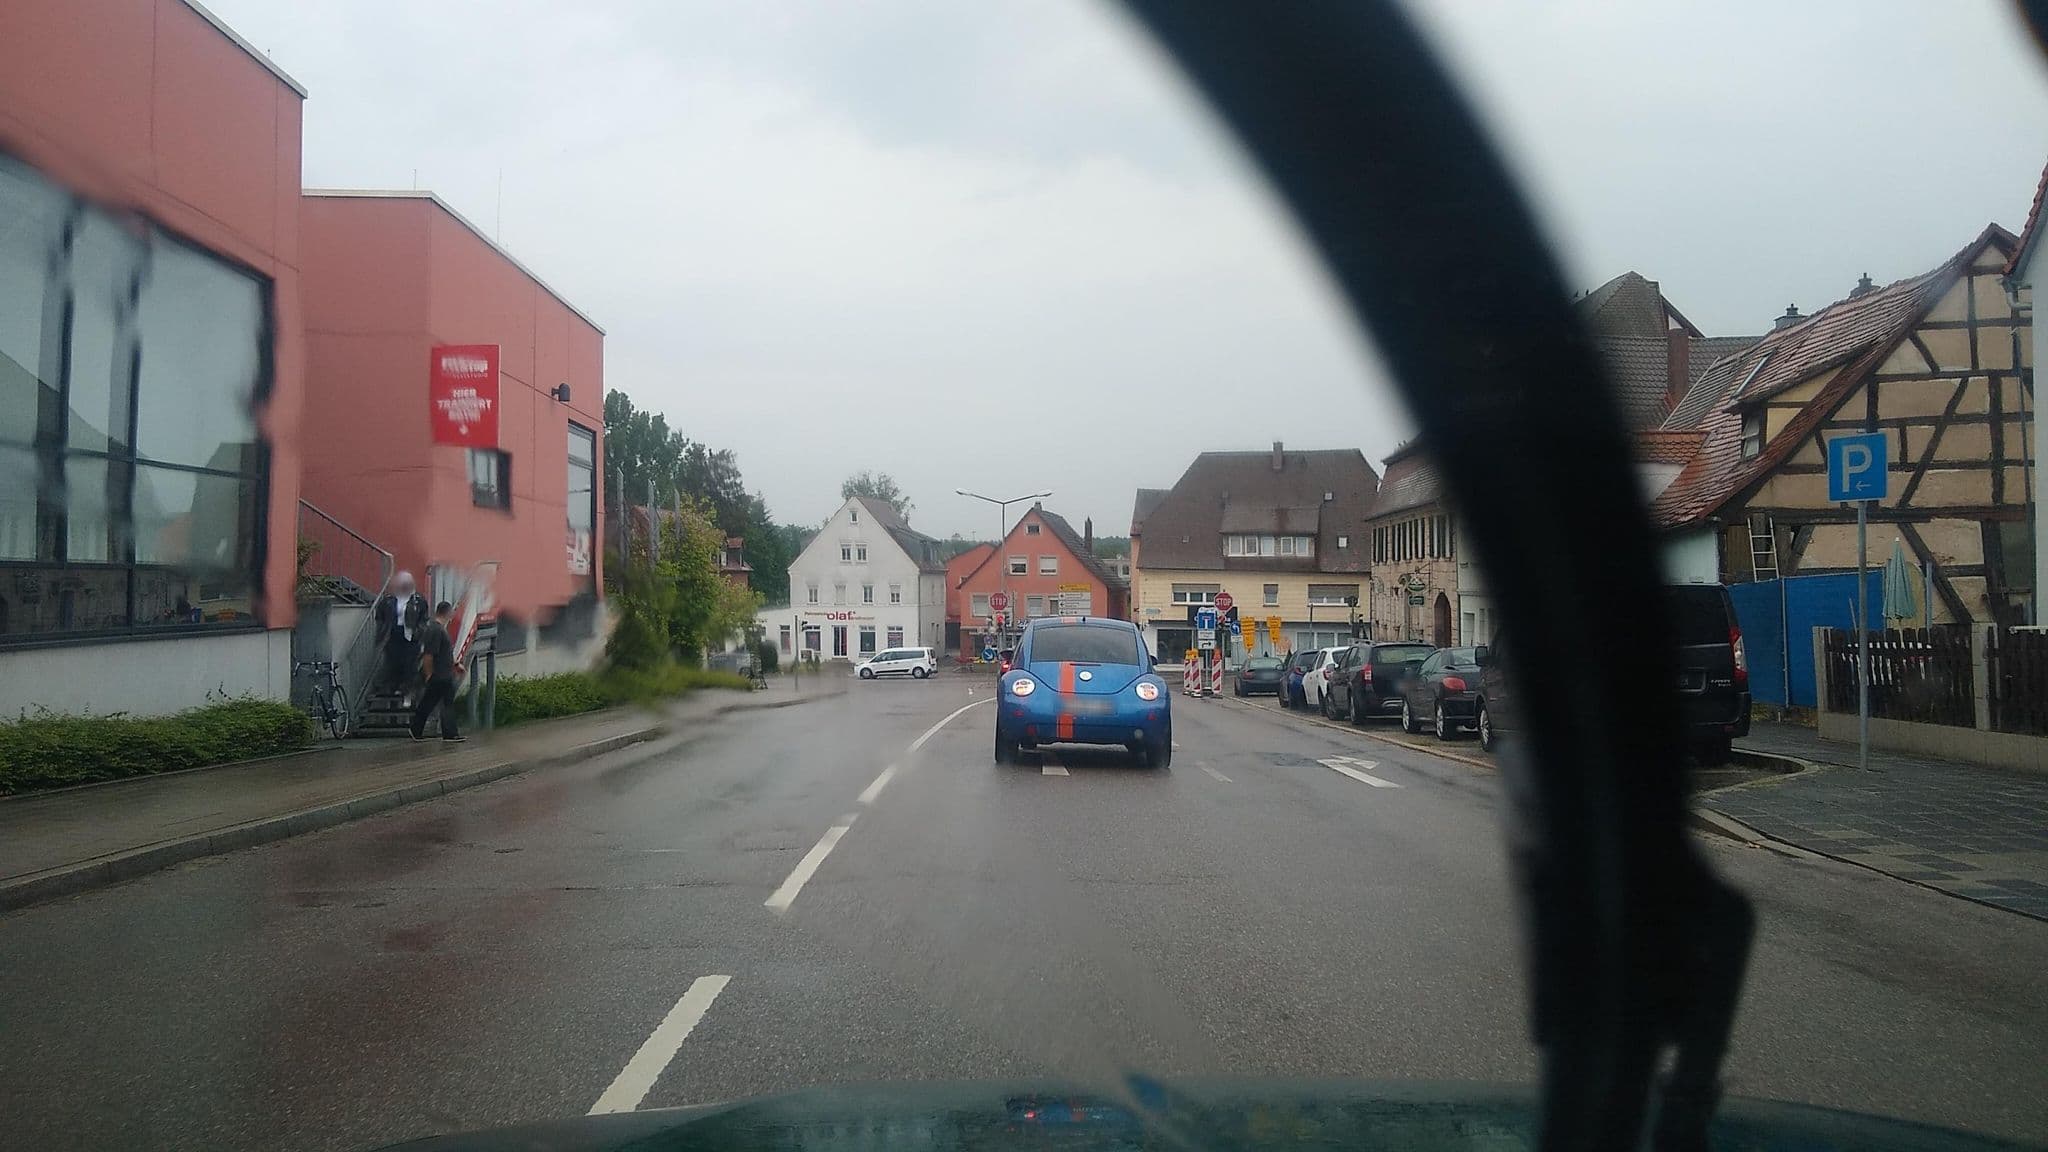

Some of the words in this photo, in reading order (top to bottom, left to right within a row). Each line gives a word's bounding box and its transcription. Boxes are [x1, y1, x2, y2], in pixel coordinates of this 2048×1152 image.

[1842, 444, 1872, 492] P
[992, 597, 1007, 606] STOP
[1215, 598, 1232, 607] STOP
